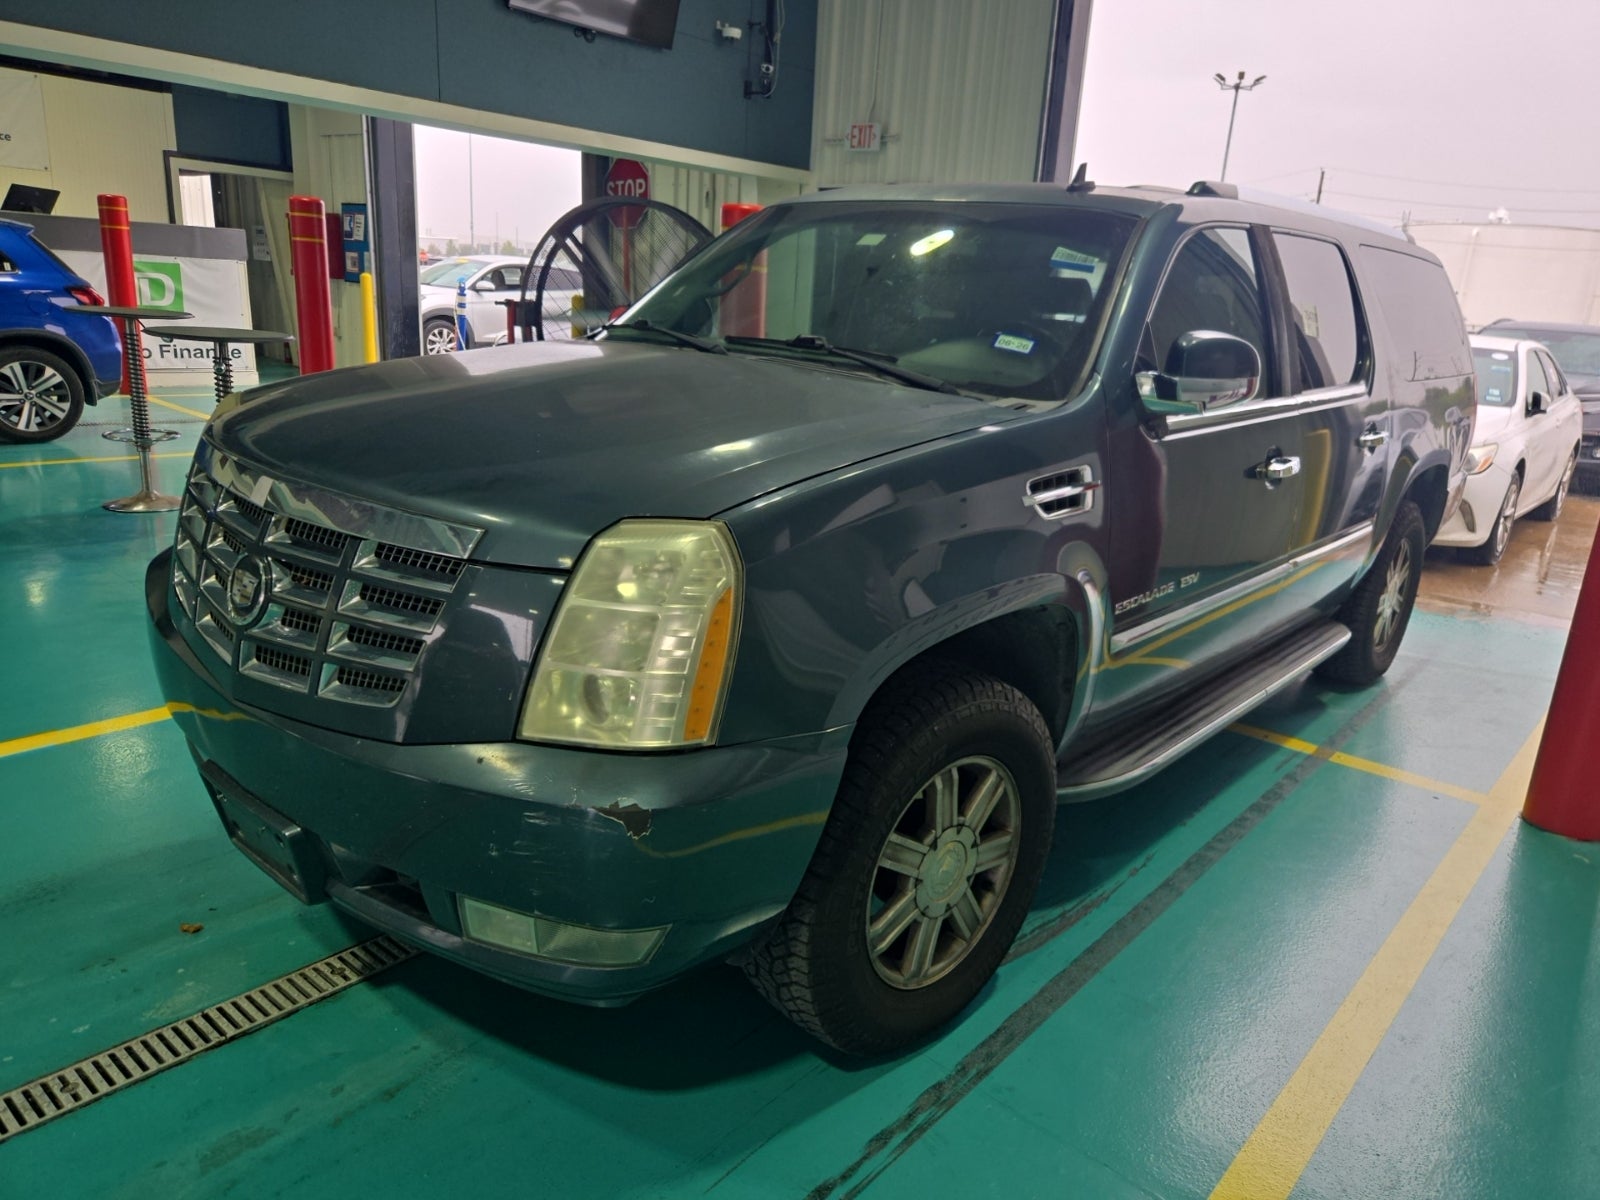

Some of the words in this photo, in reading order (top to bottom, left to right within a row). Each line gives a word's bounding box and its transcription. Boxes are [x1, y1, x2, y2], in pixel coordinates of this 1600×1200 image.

[850, 124, 874, 149] EXIT
[606, 178, 646, 198] STOP
[158, 344, 242, 359] Finane
[1114, 581, 1175, 615] ESCALADE
[1180, 571, 1200, 588] ESV
